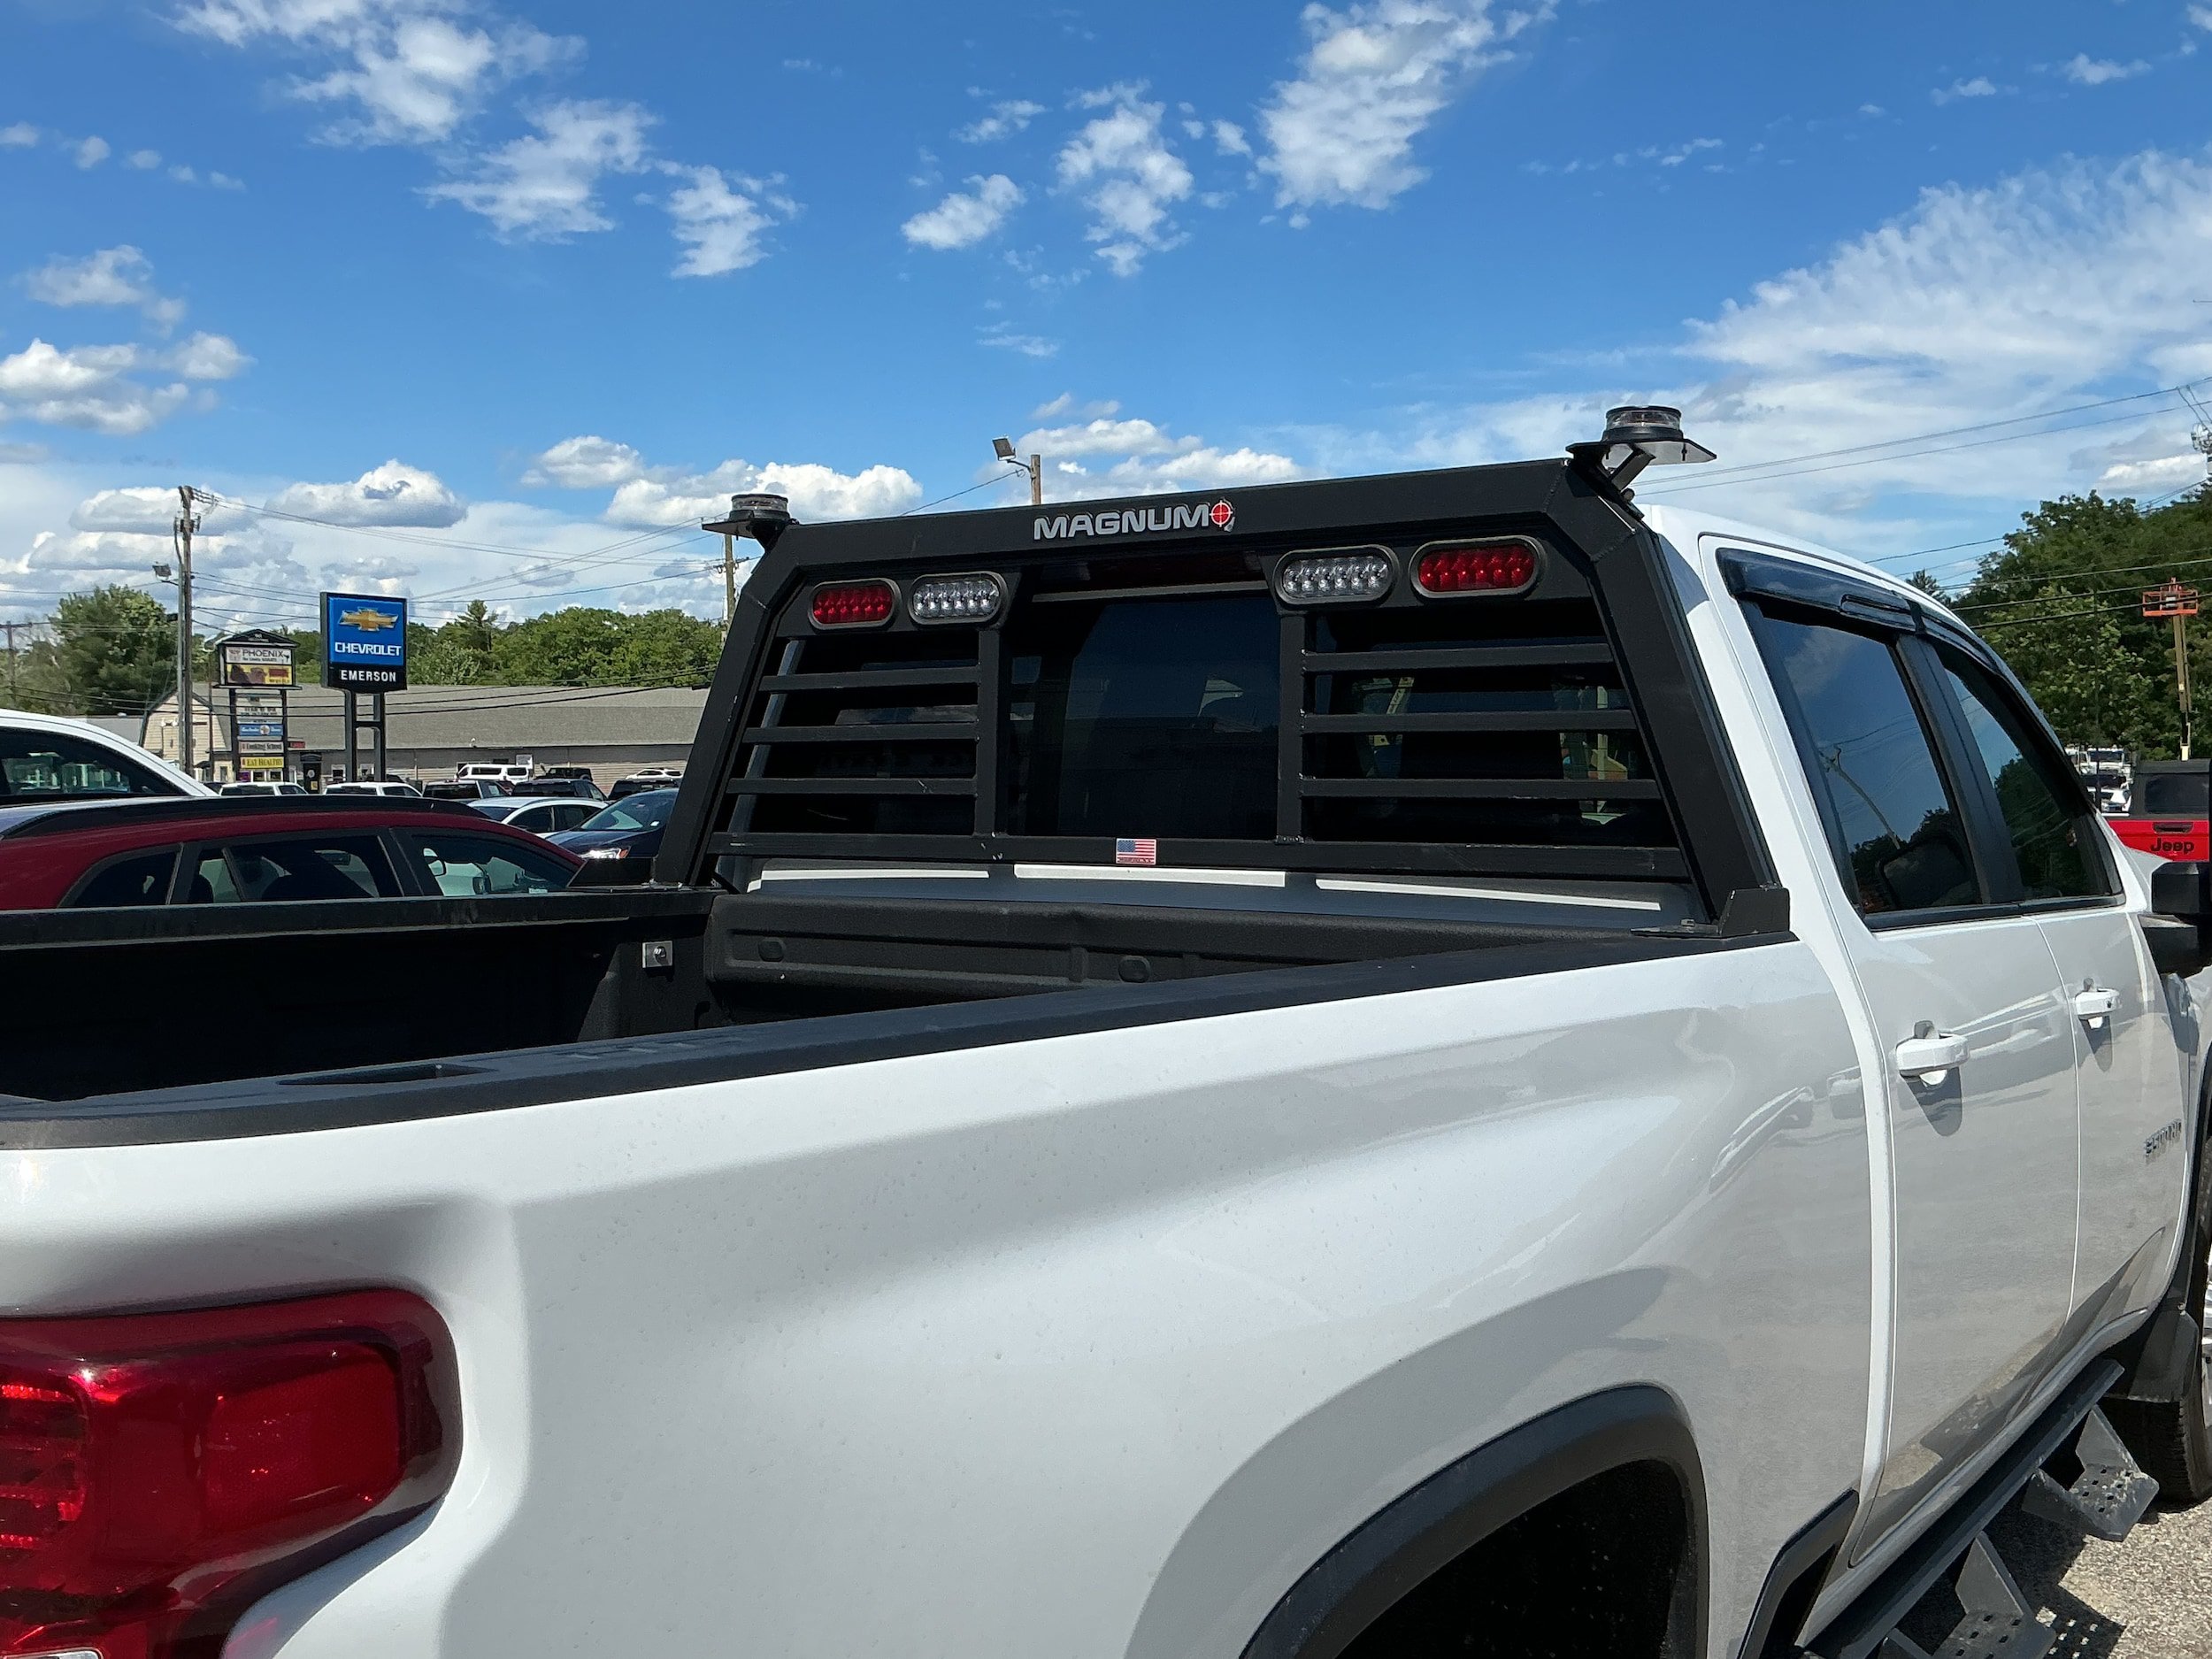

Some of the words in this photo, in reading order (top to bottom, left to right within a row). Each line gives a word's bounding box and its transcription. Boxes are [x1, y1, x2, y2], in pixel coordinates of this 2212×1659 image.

[1033, 503, 1210, 541] MAGNUM
[242, 649, 284, 658] PHOENIX
[334, 641, 402, 657] CHEVROLET
[341, 669, 396, 682] EMERSON
[2150, 837, 2194, 855] Jeep
